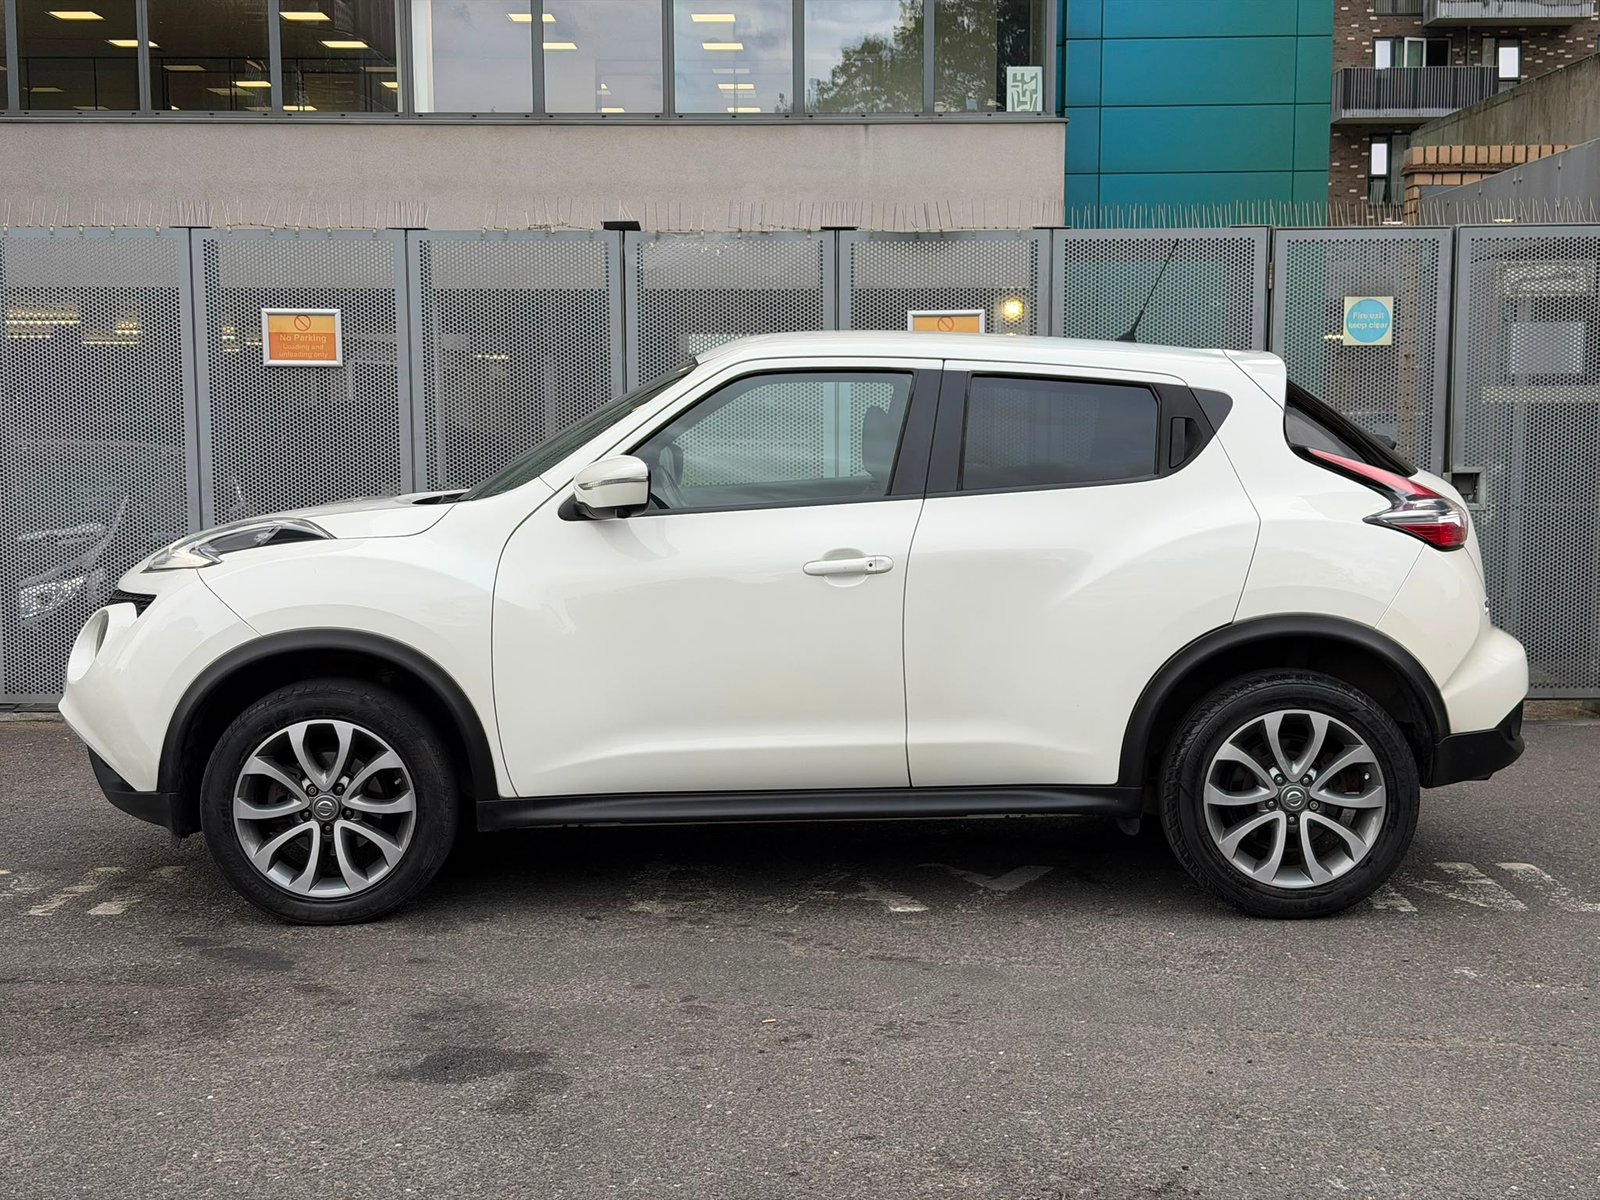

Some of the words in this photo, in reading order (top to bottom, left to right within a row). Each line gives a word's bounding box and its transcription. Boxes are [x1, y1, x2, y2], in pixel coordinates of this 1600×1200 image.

[1353, 312, 1368, 320] Fire
[1369, 312, 1384, 320] exit
[1348, 321, 1367, 330] keep
[1368, 321, 1388, 329] clear
[279, 334, 292, 342] No
[294, 334, 327, 344] Parking
